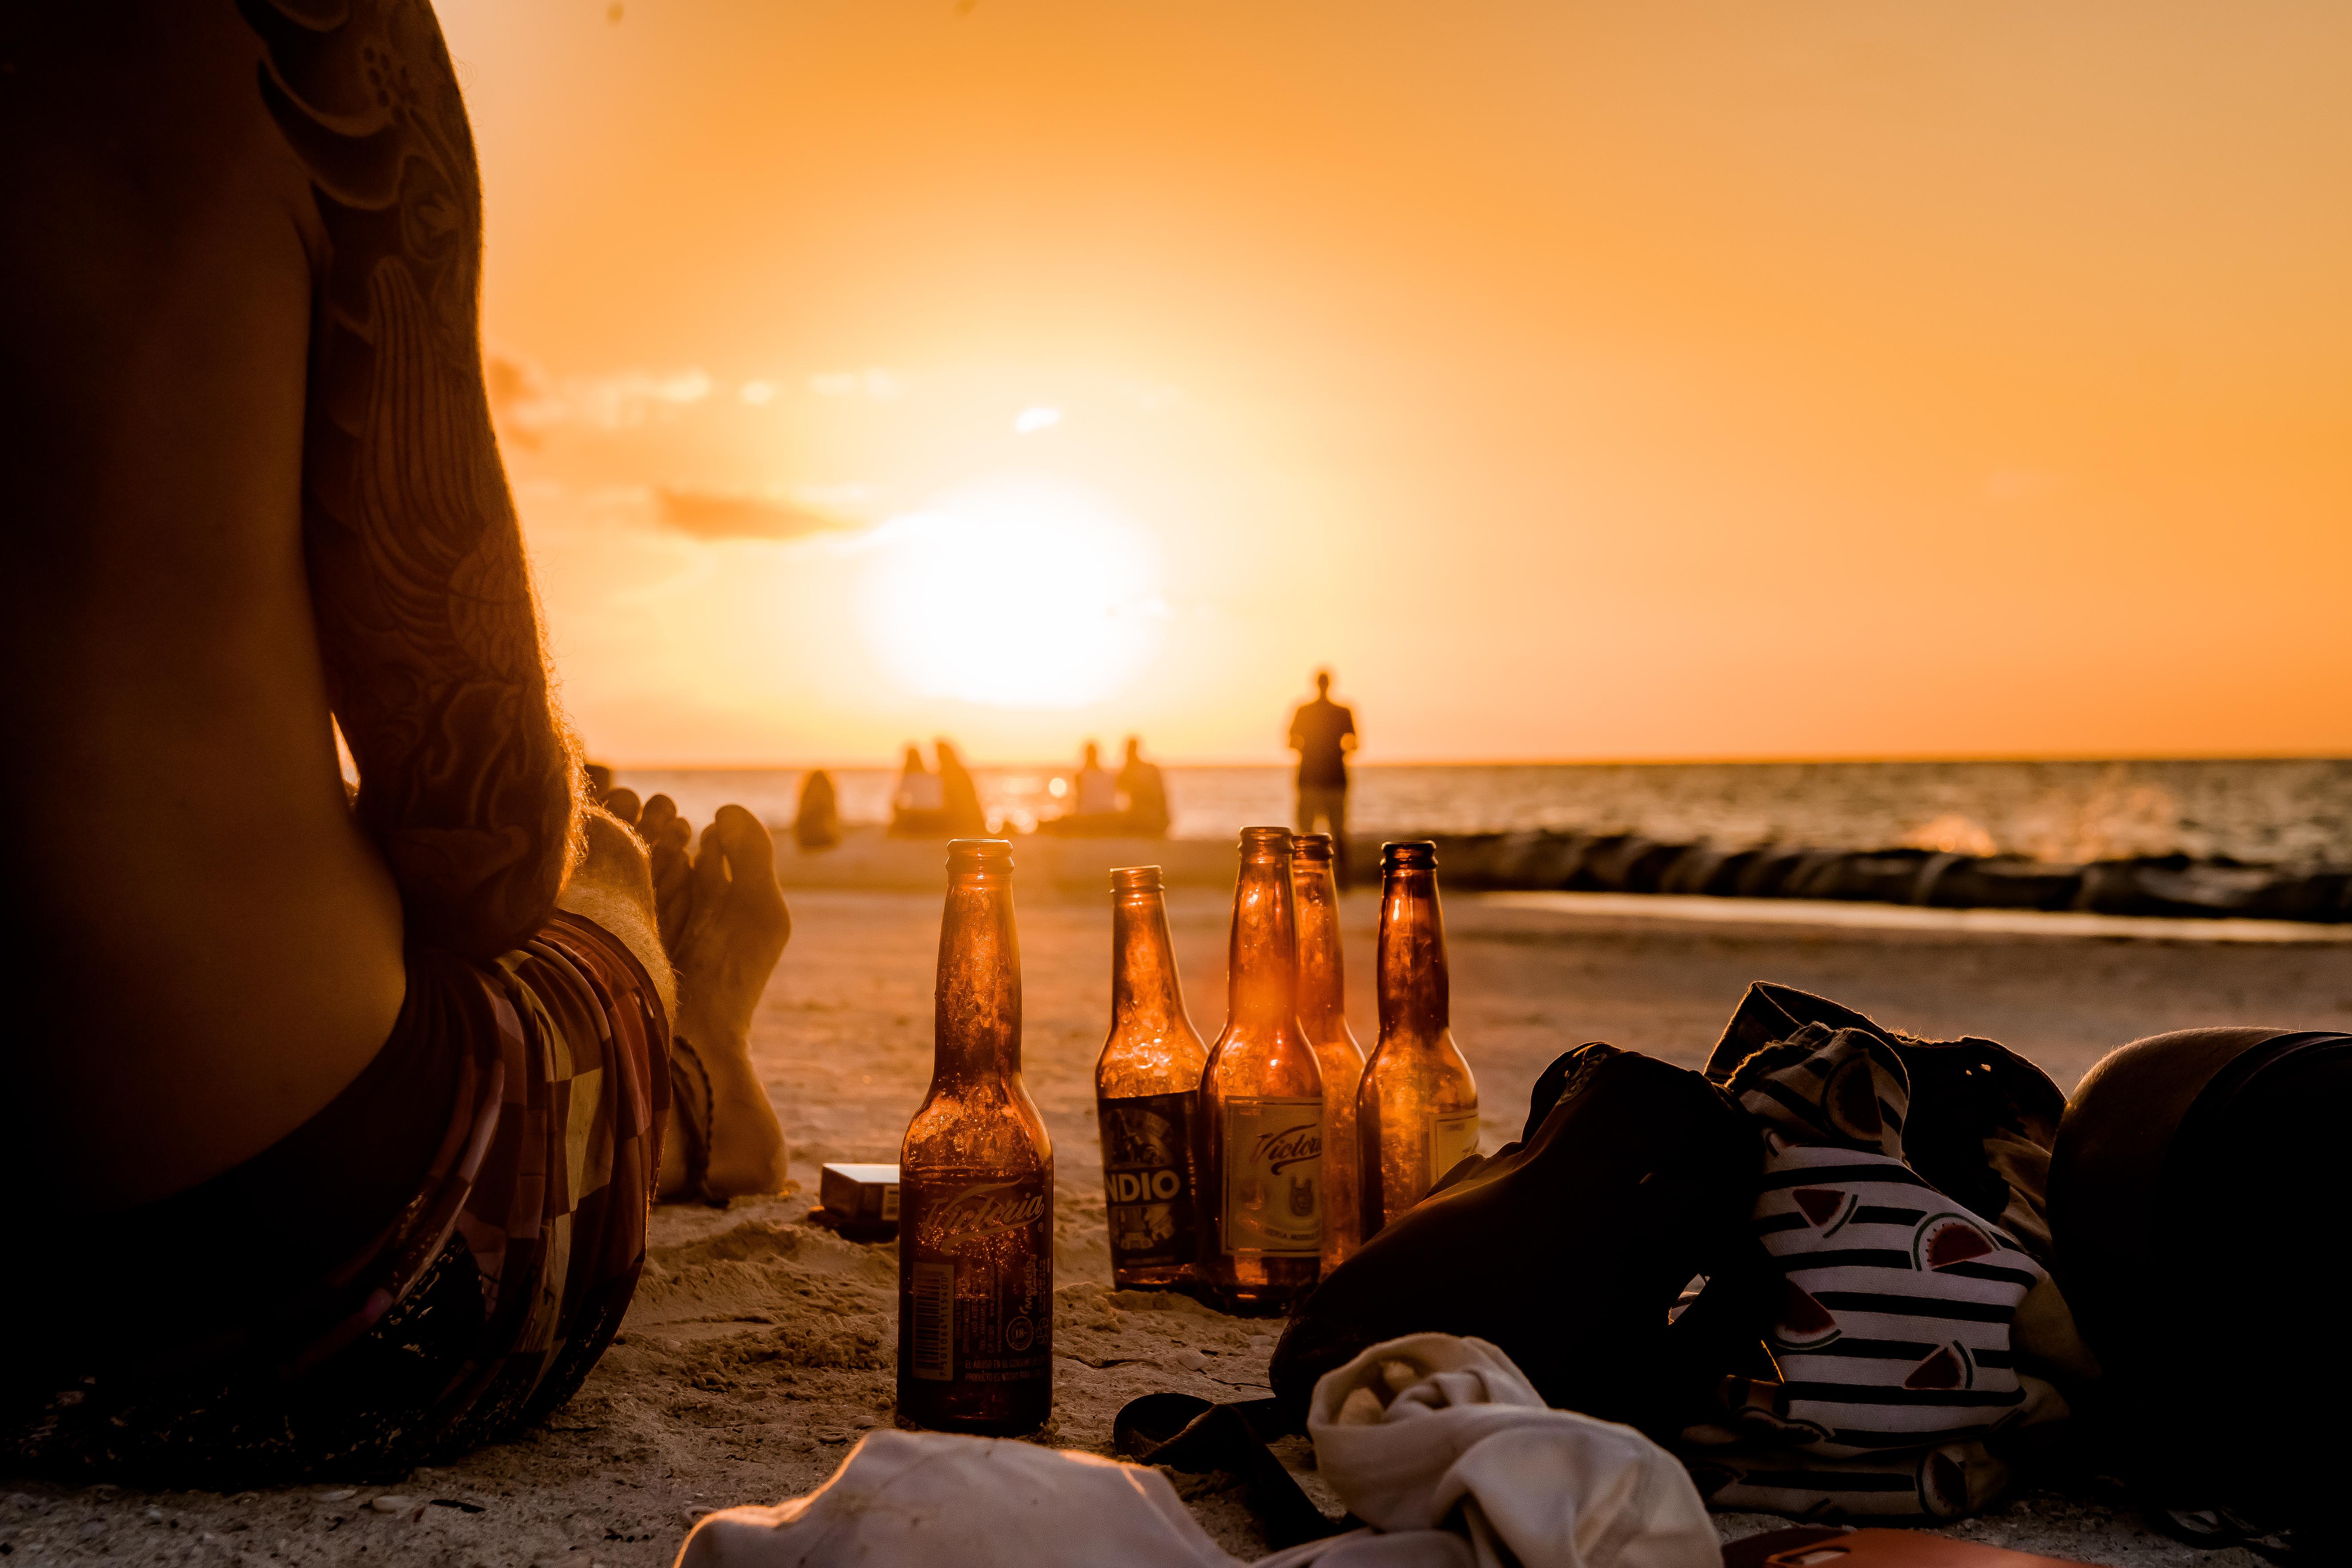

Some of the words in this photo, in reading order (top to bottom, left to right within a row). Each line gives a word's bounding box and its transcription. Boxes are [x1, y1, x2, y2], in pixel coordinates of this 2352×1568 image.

[923, 1176, 1044, 1256] Victoria
[965, 1359, 971, 1369] EL
[973, 1359, 992, 1369] ABUSO
[993, 1359, 1000, 1368] EN
[1002, 1358, 1008, 1368] EL
[965, 1372, 993, 1382] PRODUCTO
[994, 1372, 1000, 1382] ES
